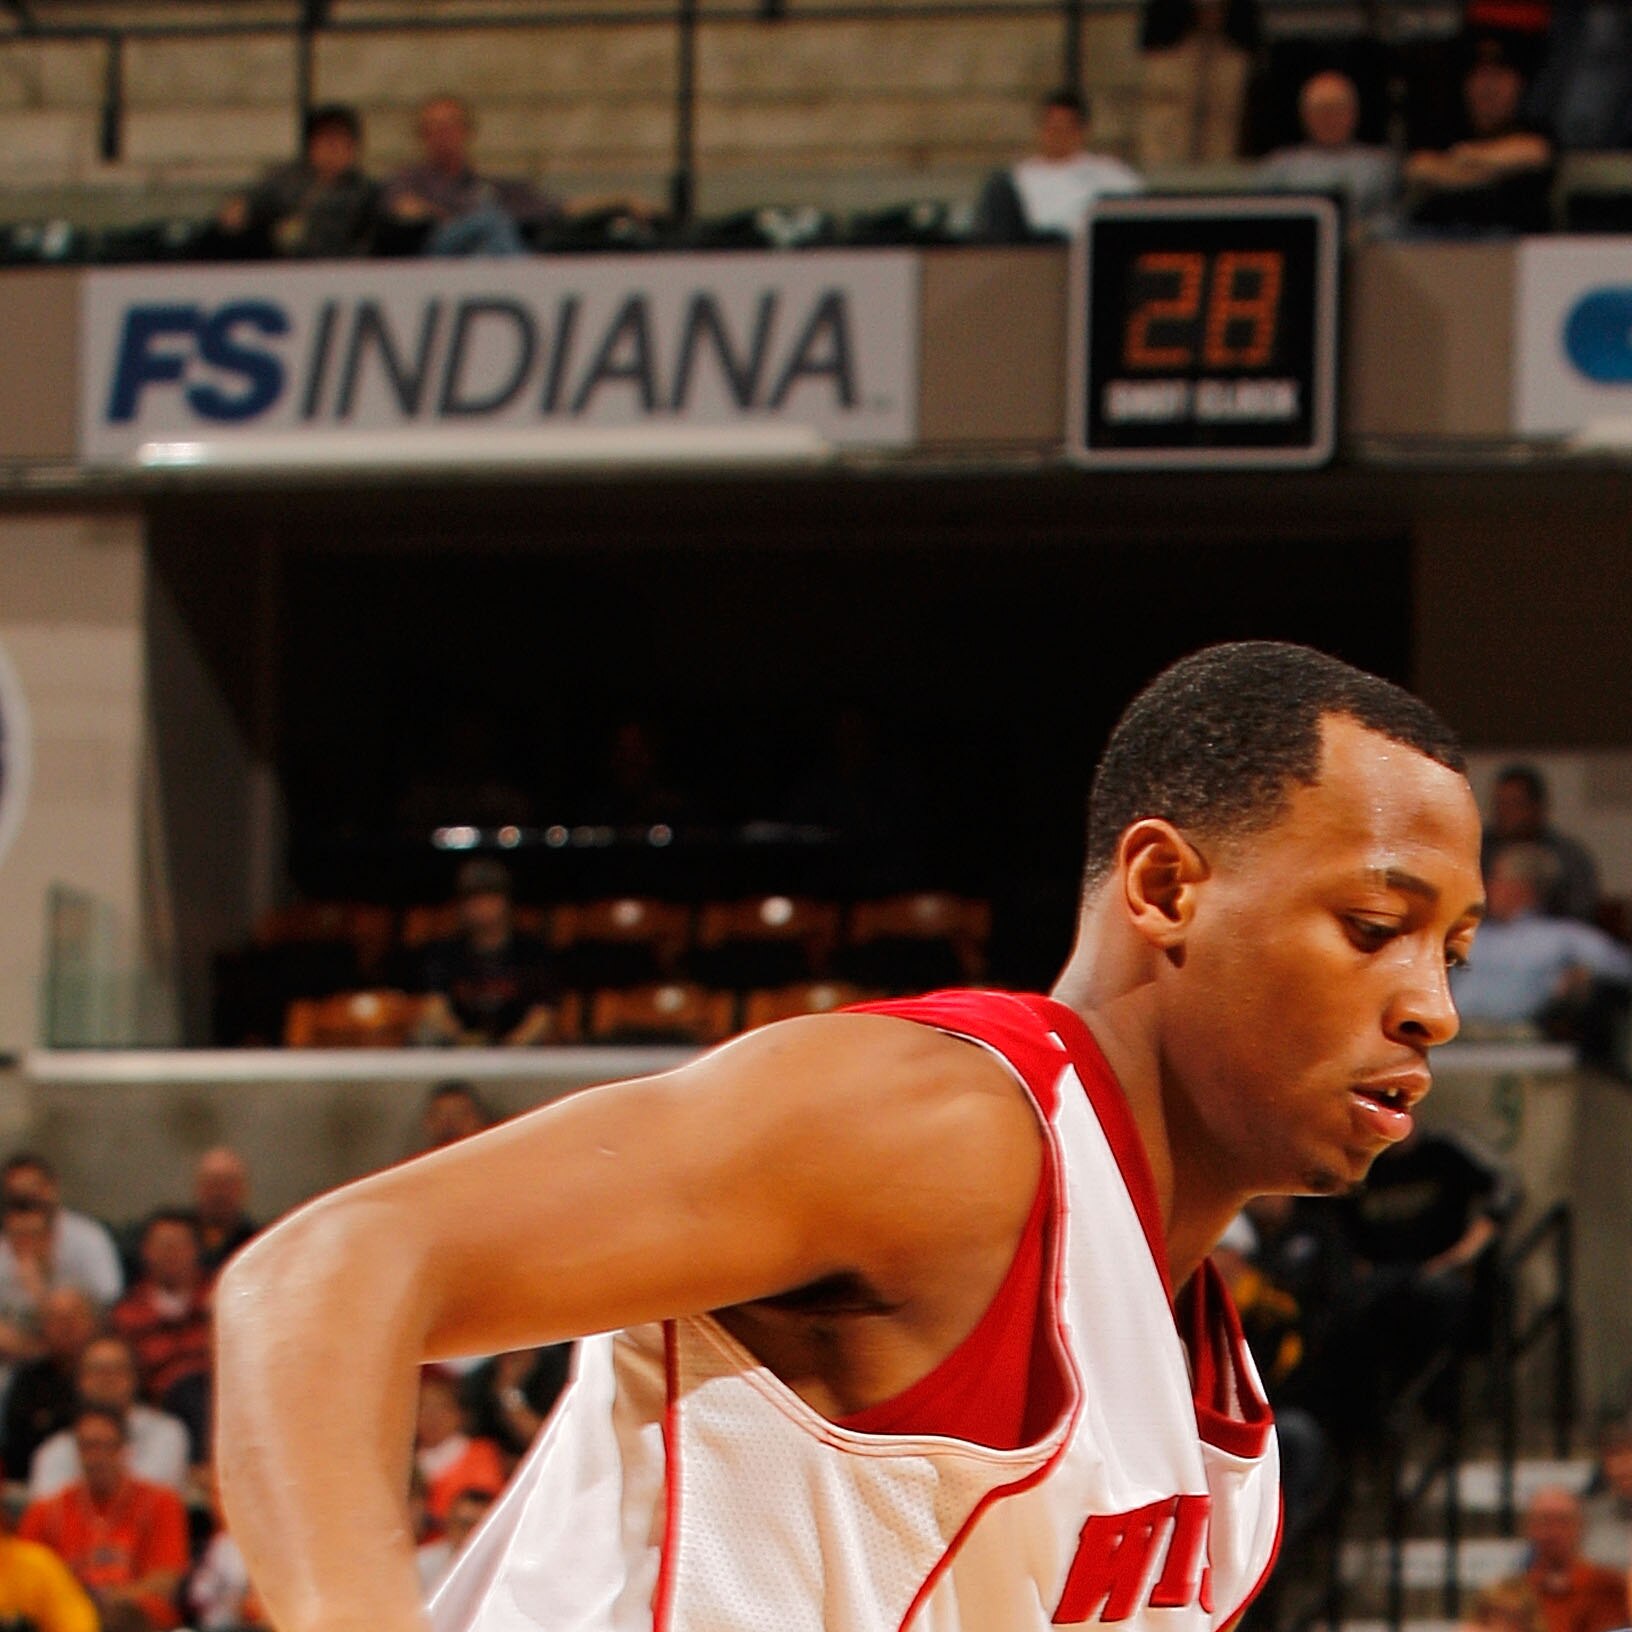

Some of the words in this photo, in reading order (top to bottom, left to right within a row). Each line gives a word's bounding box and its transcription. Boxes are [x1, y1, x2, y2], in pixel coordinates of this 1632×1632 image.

[105, 300, 293, 424] FS
[299, 286, 862, 422] INDIANA
[1121, 249, 1285, 369] 28
[1050, 1494, 1215, 1625] WI
